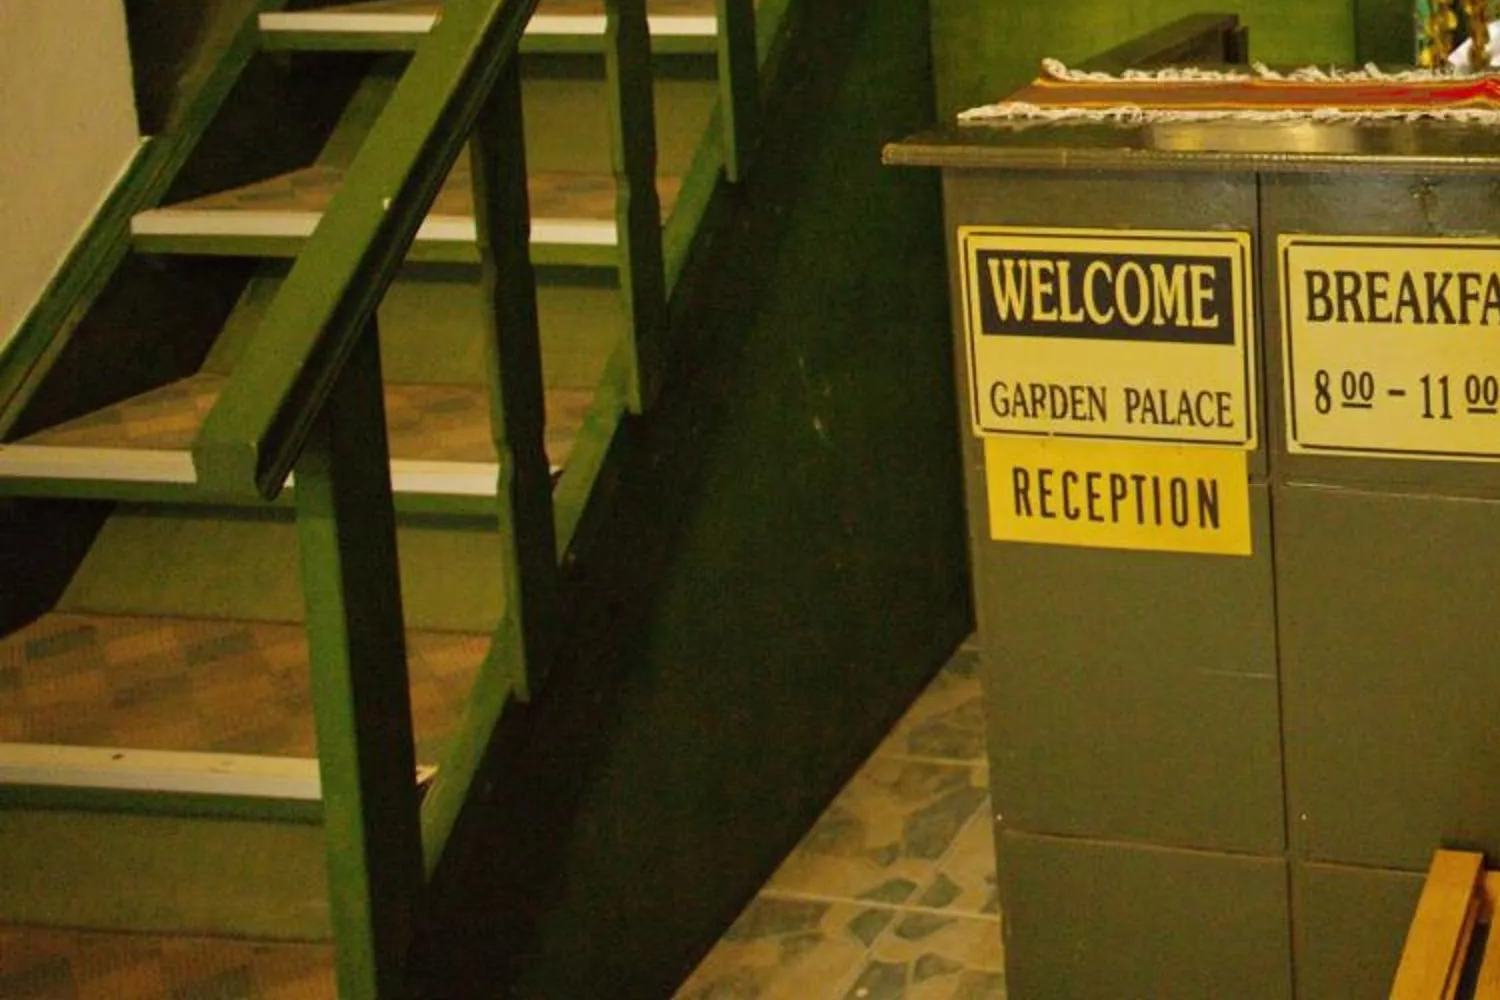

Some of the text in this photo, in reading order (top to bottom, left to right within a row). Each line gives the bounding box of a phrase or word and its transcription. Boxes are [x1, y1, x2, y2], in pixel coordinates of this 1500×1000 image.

[987, 258, 1219, 328] WELCOME
[989, 381, 1235, 429] GARDEN PALACE
[1012, 467, 1220, 530] RECEPTION
